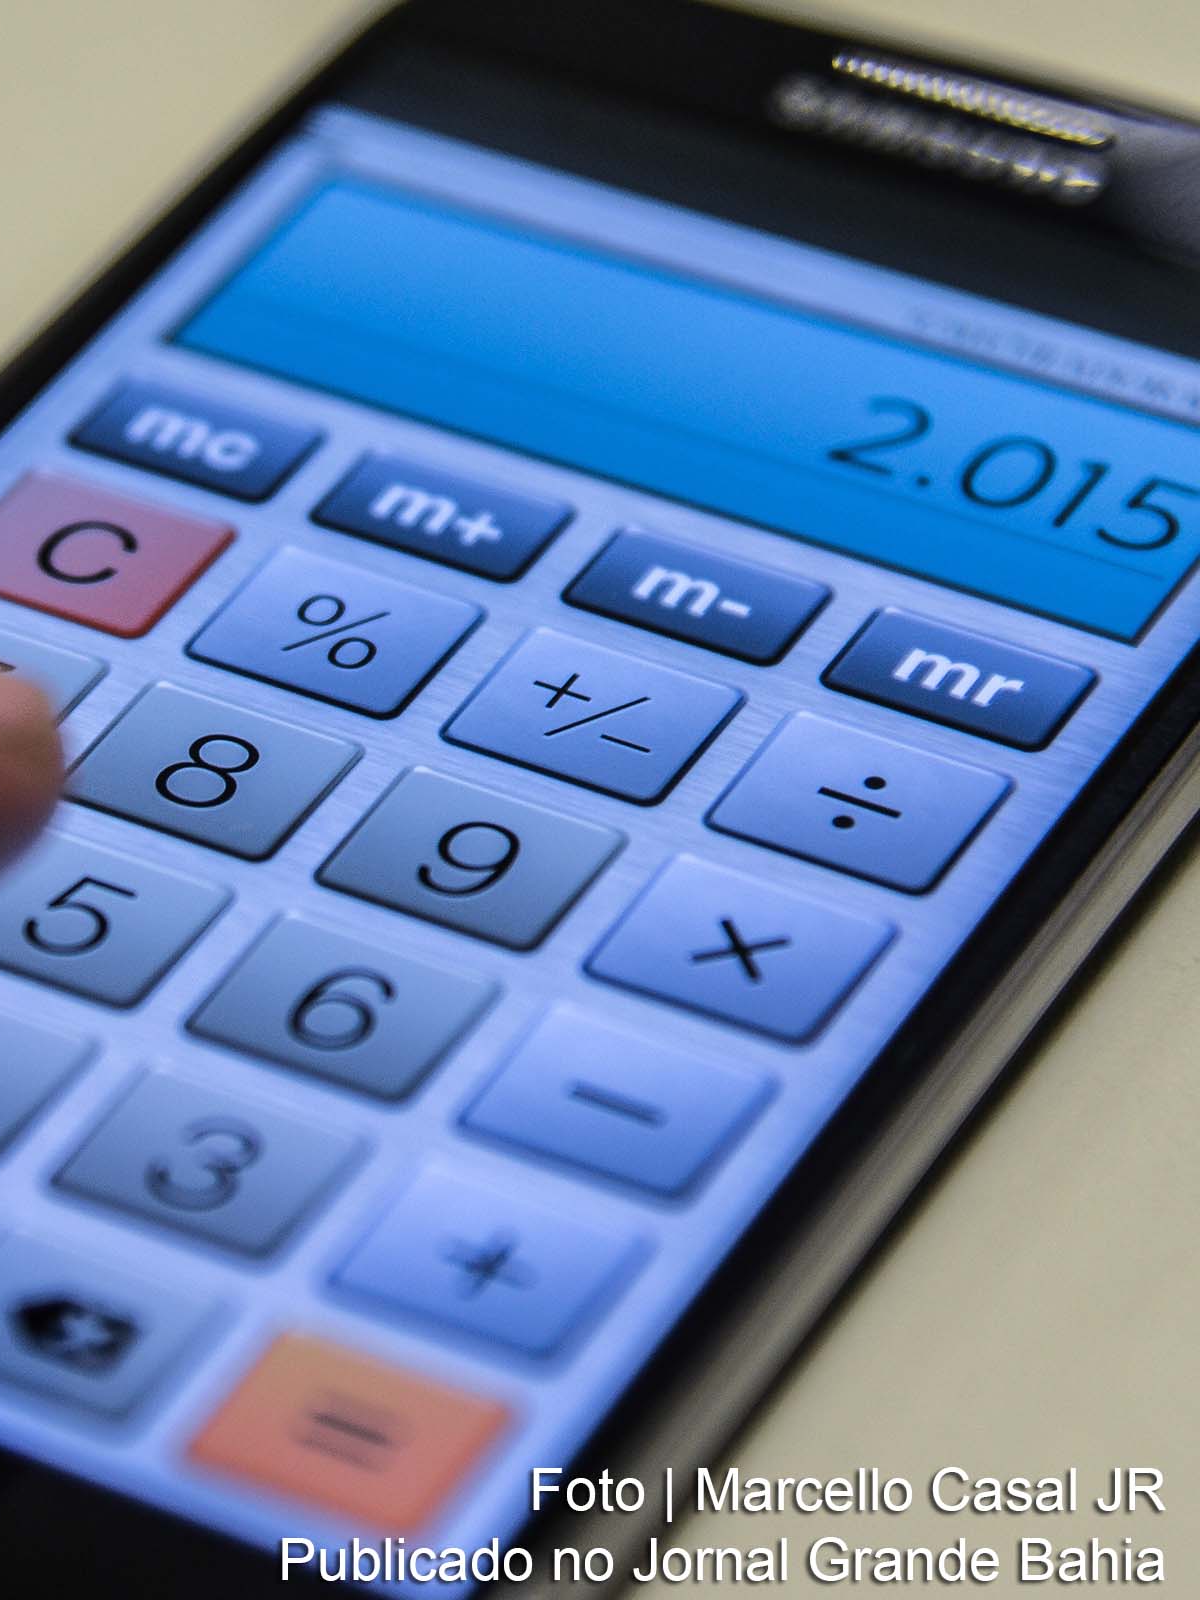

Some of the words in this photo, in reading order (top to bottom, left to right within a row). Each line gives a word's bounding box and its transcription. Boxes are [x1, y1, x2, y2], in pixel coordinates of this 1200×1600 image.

[125, 404, 260, 472] mc
[827, 396, 1200, 551] 2.015
[36, 520, 138, 584] C
[370, 484, 503, 548] m+
[631, 564, 753, 619] m-
[281, 594, 391, 670] %
[893, 645, 1026, 707] mr
[154, 733, 260, 809] 8
[417, 820, 522, 898] 9
[22, 875, 137, 957] 5
[287, 967, 397, 1051] 6
[143, 1117, 264, 1212] 3
